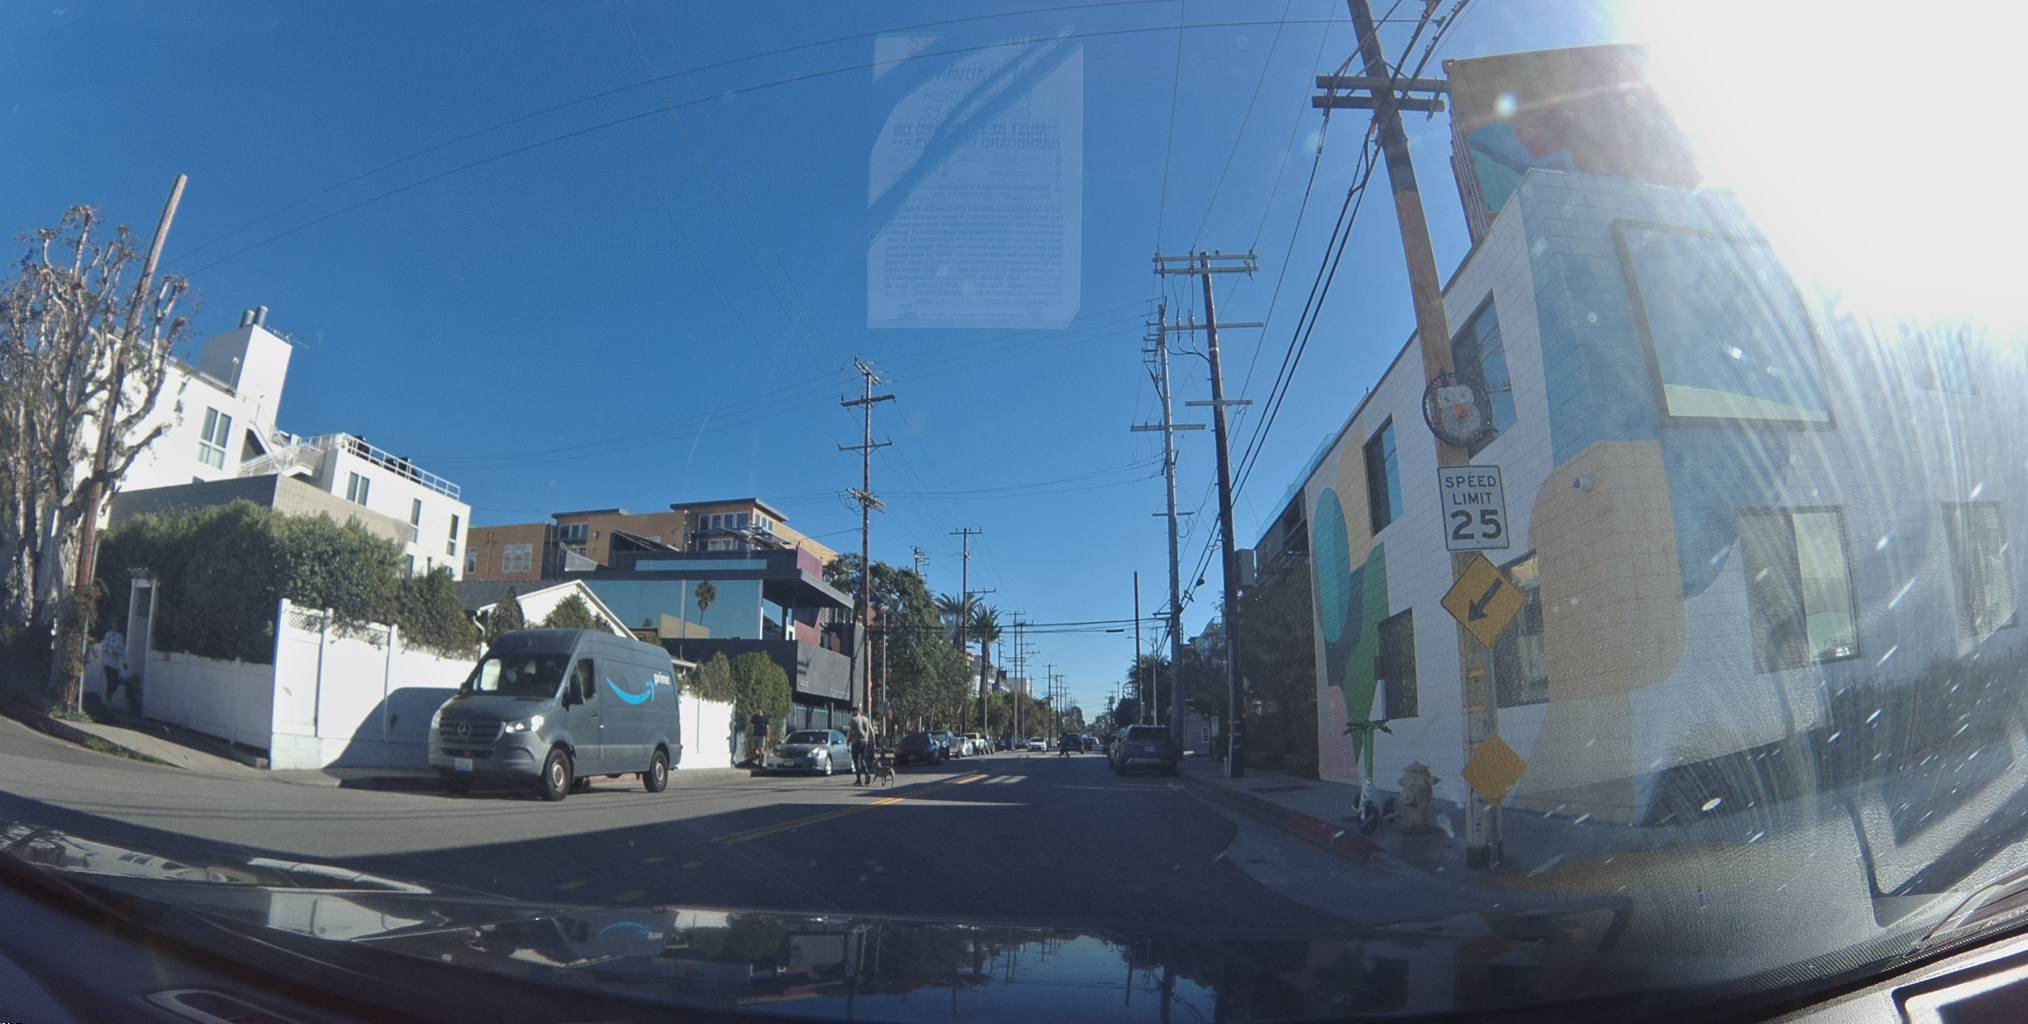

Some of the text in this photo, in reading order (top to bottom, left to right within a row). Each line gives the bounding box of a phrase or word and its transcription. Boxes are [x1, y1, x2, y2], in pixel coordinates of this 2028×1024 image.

[1445, 475, 1497, 488] SPEED
[1452, 491, 1493, 505] LIMIT
[1450, 509, 1502, 540] 25
